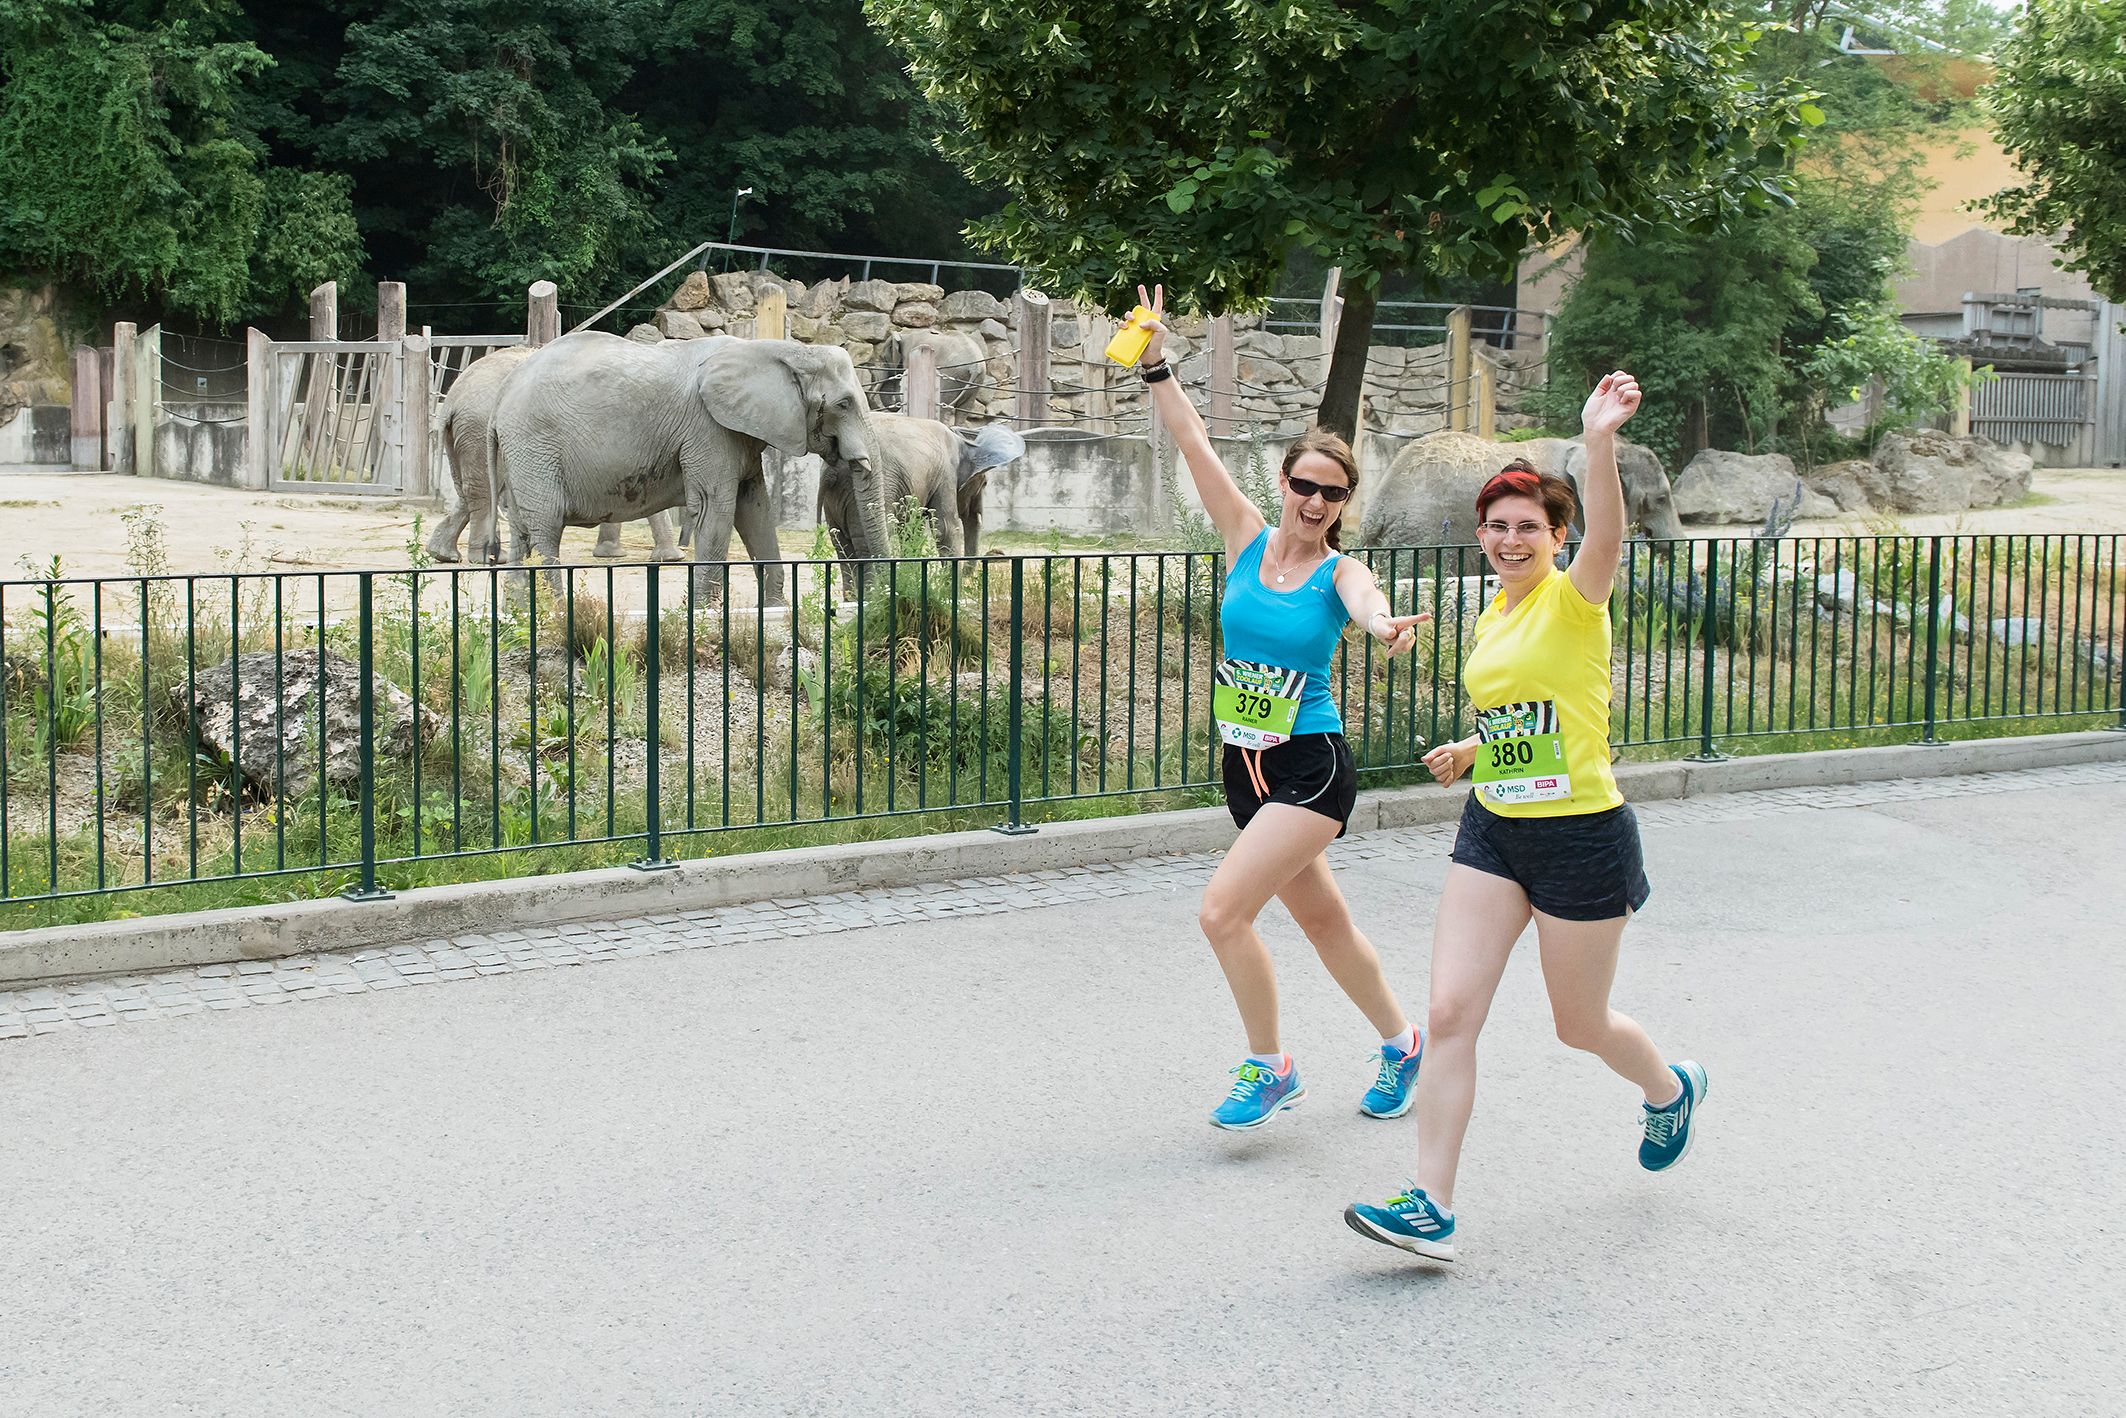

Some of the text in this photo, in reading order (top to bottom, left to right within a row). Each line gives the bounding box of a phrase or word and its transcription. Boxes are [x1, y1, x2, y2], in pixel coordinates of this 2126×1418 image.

[1235, 692, 1272, 719] 379
[1243, 731, 1256, 741] MSD
[1264, 735, 1279, 743] BIPA
[1491, 740, 1533, 768] 380
[1499, 767, 1524, 775] KATHRIN
[1507, 784, 1526, 793] MSD
[1536, 780, 1555, 788] BIPA
